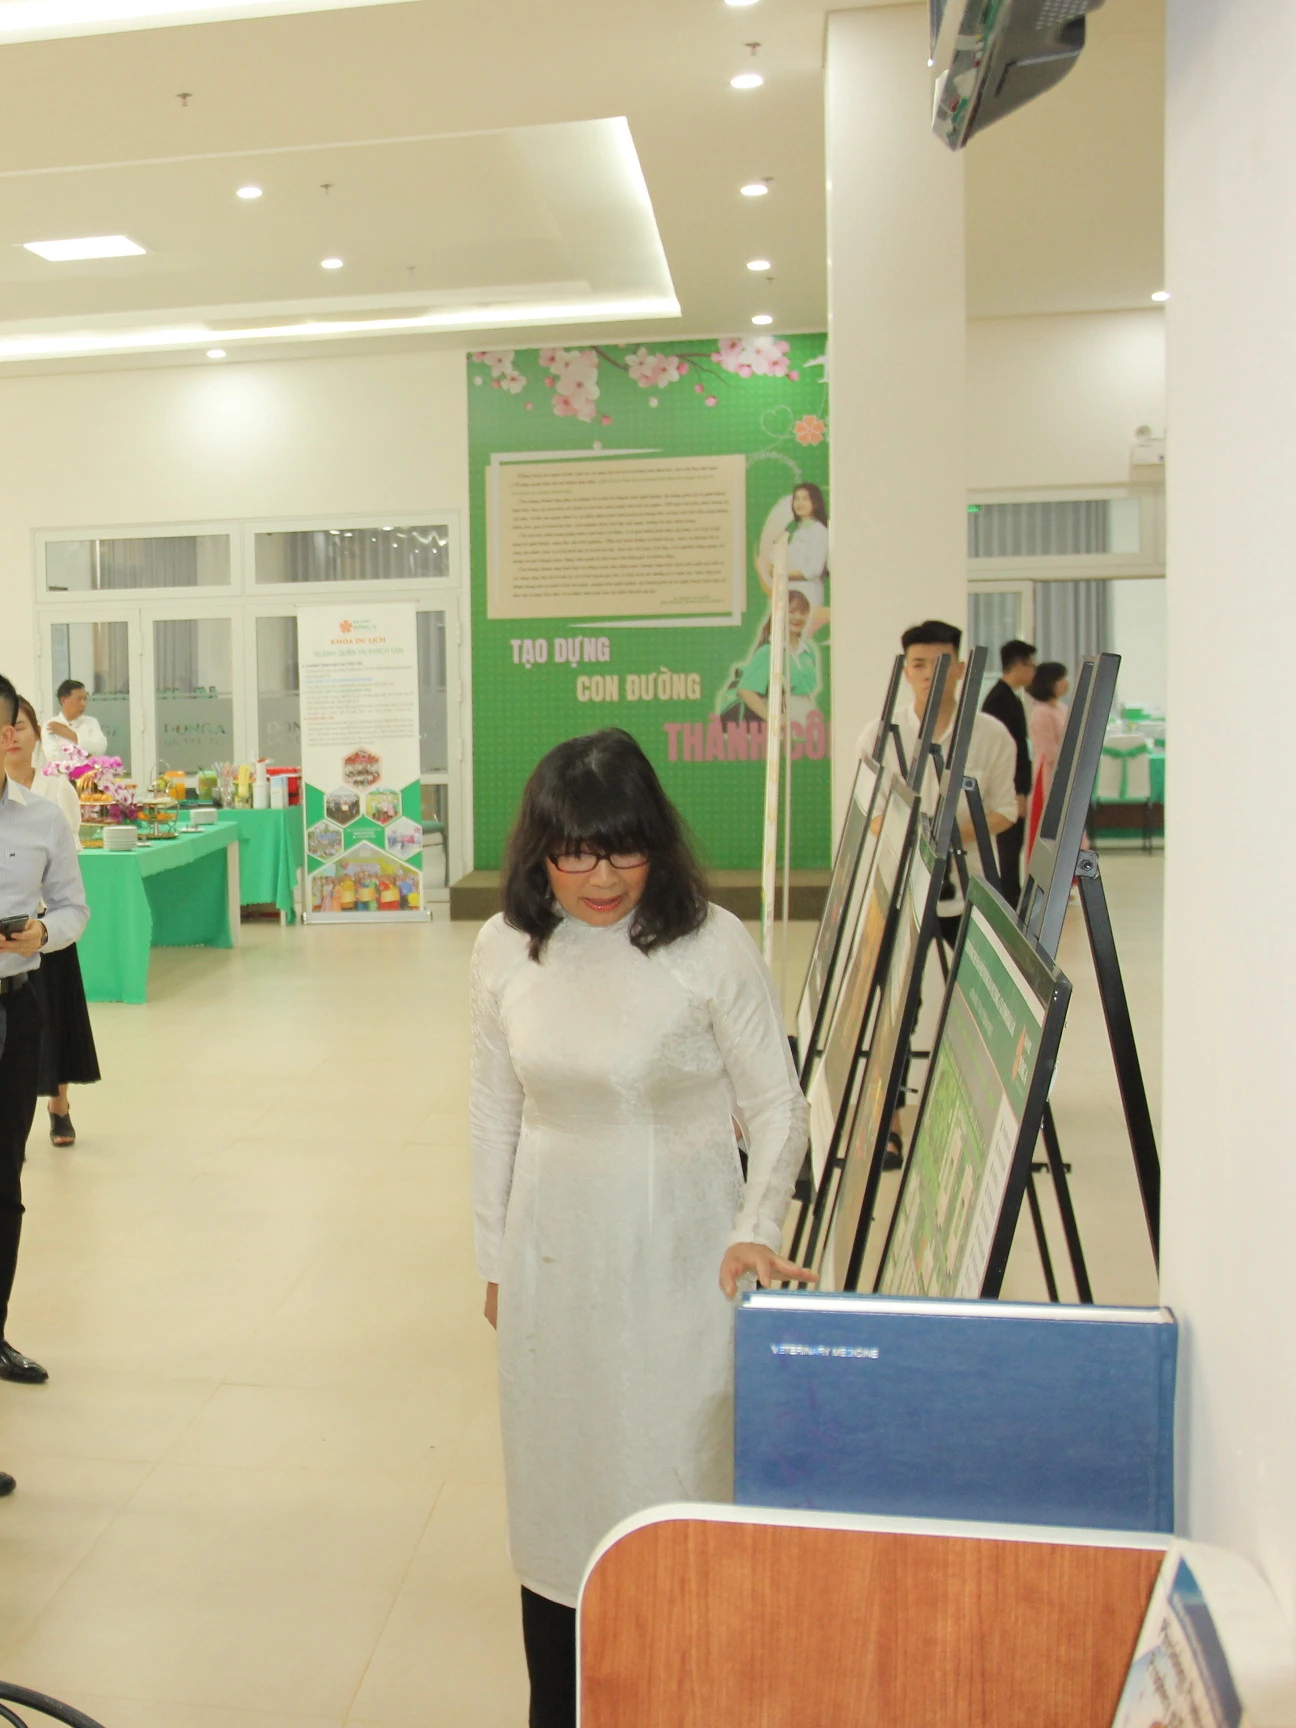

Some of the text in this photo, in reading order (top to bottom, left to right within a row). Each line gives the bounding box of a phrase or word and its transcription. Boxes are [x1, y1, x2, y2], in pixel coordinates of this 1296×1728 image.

[511, 636, 611, 669] TẠO DỰNG
[577, 666, 701, 702] CON ĐƯỜNG
[663, 713, 768, 762] THÀNH
[770, 1343, 880, 1359] VETERINARY MEDICINE
